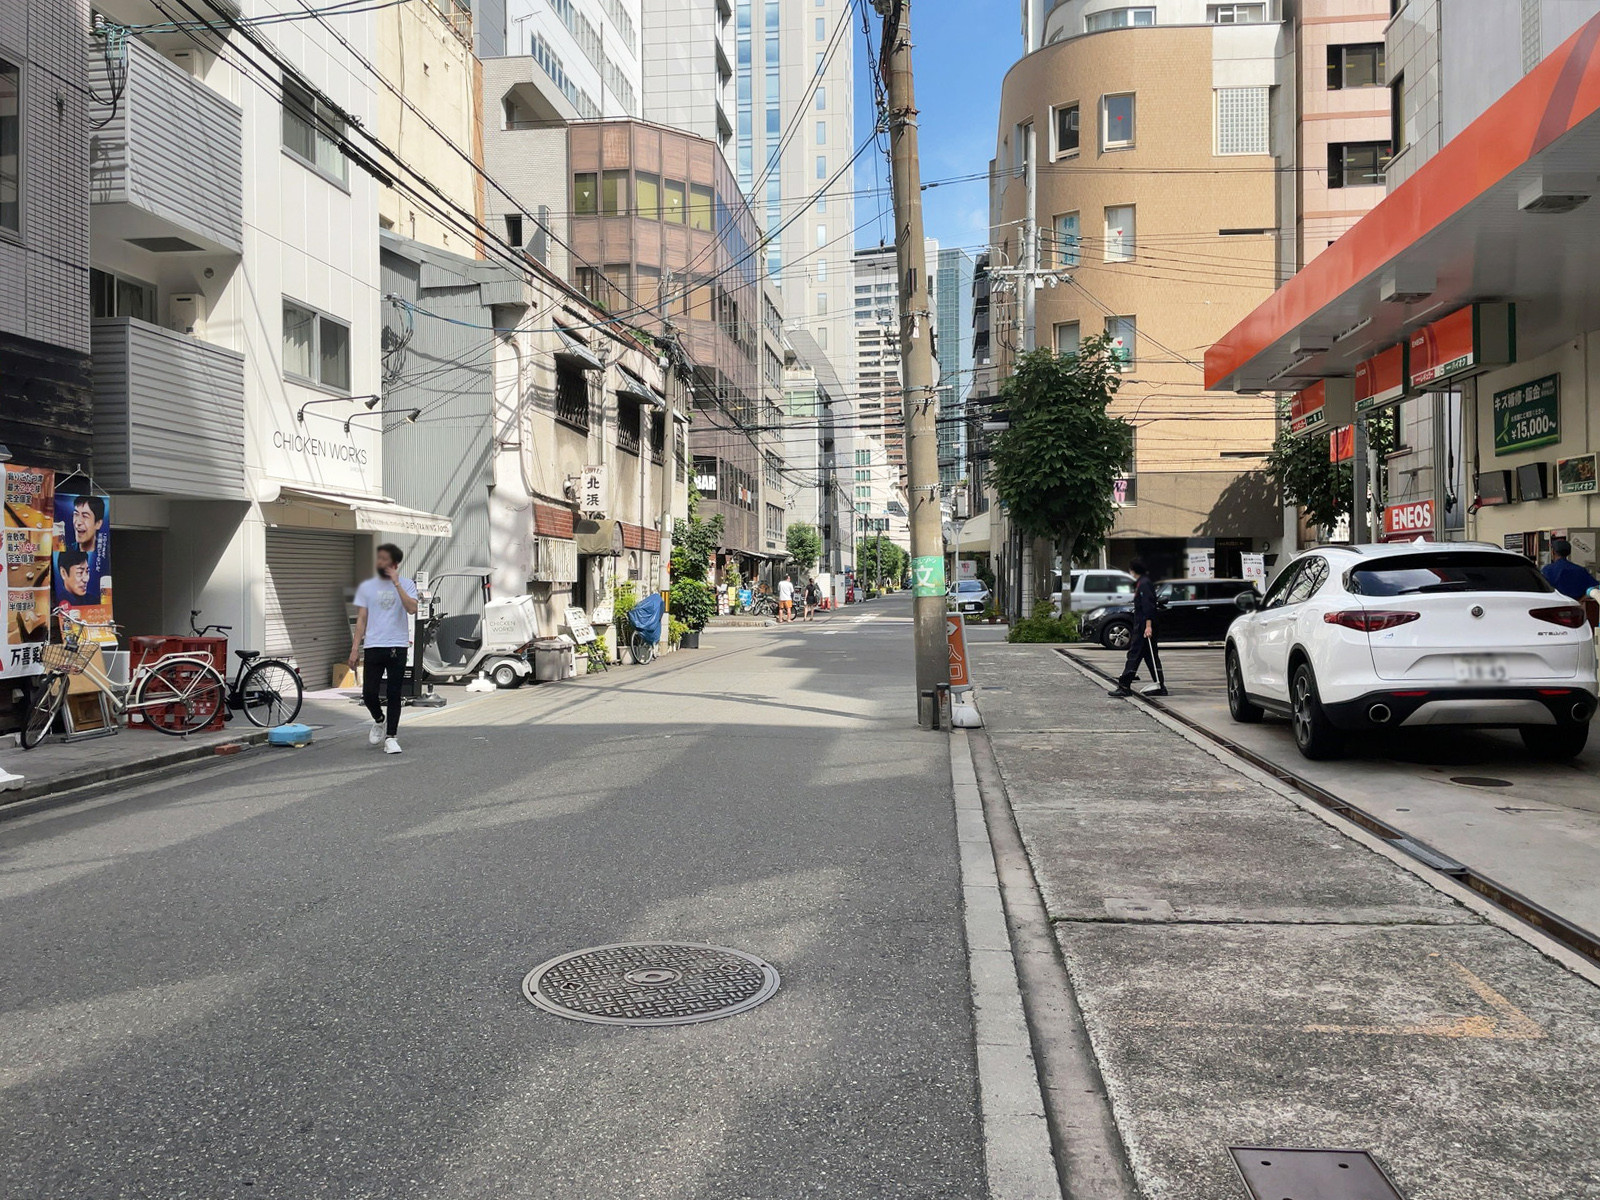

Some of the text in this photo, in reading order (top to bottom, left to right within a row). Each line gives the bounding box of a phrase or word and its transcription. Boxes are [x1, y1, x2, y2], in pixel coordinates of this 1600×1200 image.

[273, 431, 367, 465] CHICKEN WORKS
[6, 494, 32, 504] 完全個室
[586, 475, 600, 506] 北浜
[1392, 503, 1431, 530] ENEOS
[8, 553, 35, 563] 完全個室
[948, 644, 963, 680] 入口
